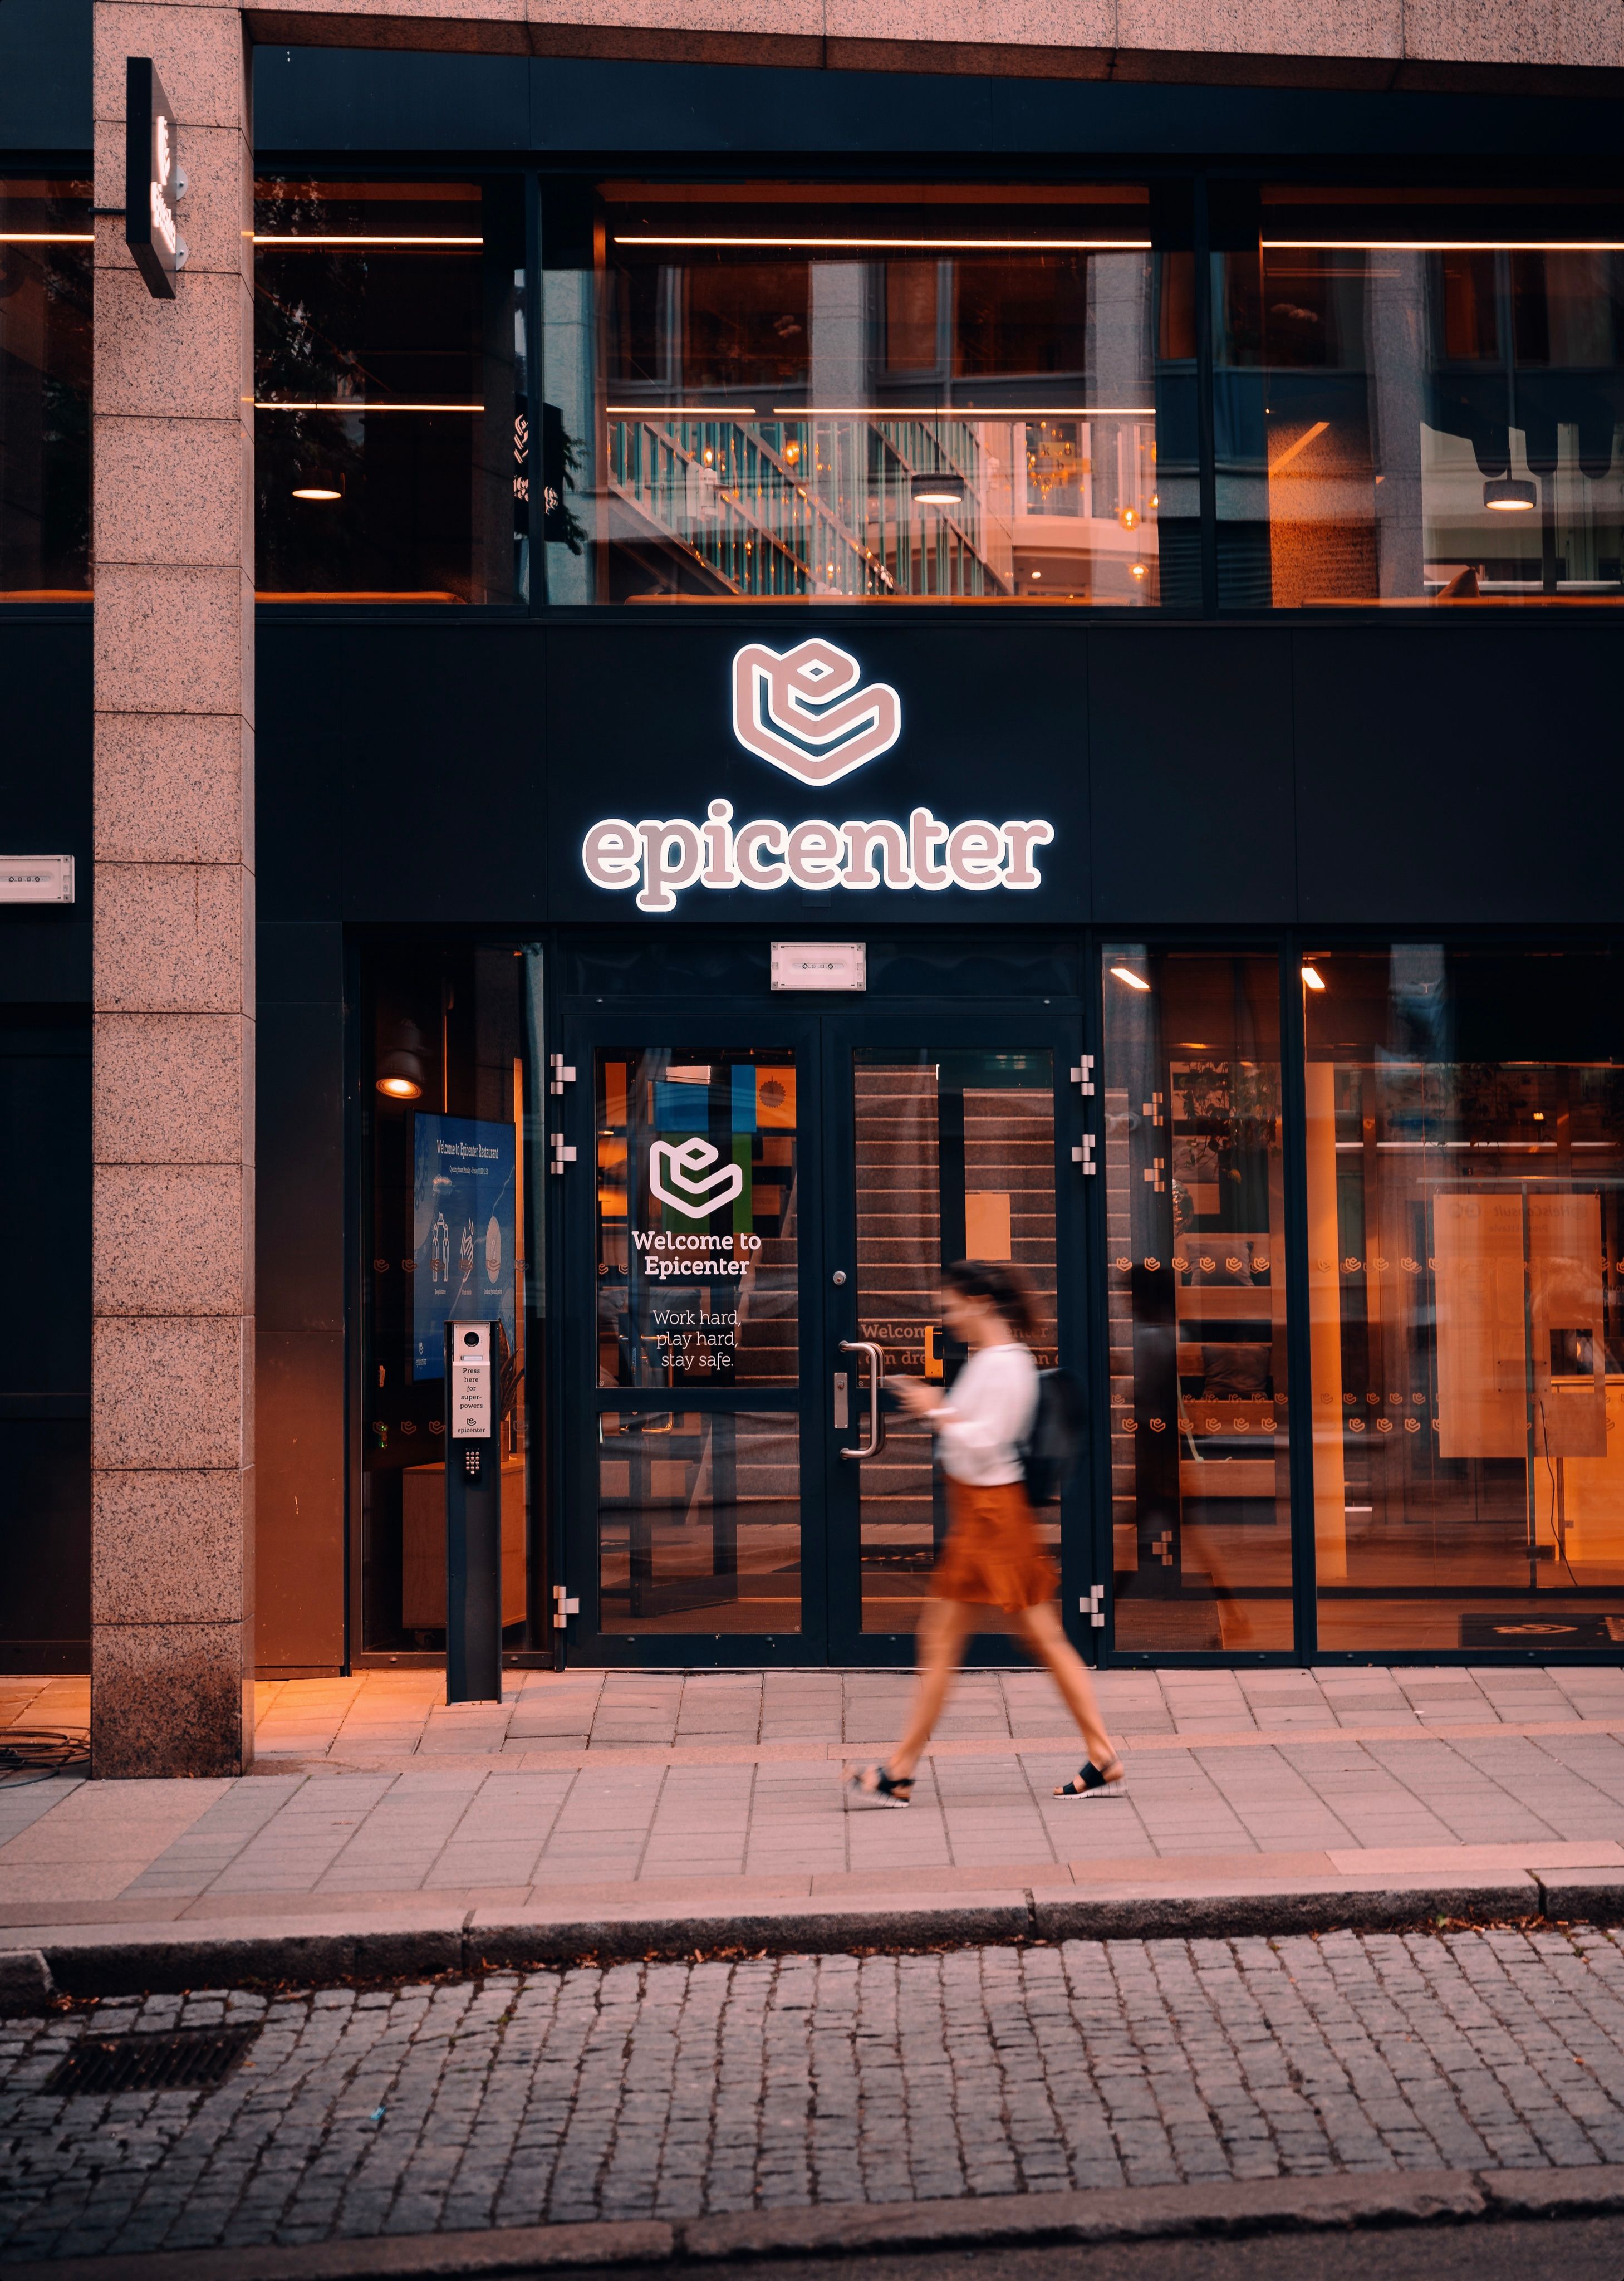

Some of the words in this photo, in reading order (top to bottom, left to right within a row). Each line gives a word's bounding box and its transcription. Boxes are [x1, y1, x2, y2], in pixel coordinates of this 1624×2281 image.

[583, 799, 1054, 912] epicenter
[436, 1139, 455, 1156] Welcome
[455, 1143, 460, 1156] to
[460, 1142, 478, 1159] Epicenter
[478, 1144, 499, 1159] Restaurant
[632, 1231, 733, 1251] Welcome
[740, 1232, 761, 1251] to
[644, 1256, 750, 1280] Epicenter
[652, 1310, 695, 1325] Work
[699, 1310, 742, 1328] hard,
[656, 1331, 693, 1349] play
[696, 1332, 739, 1349] hard,
[860, 1324, 925, 1338] Welcom
[661, 1354, 694, 1370] stay
[699, 1352, 734, 1370] safe.
